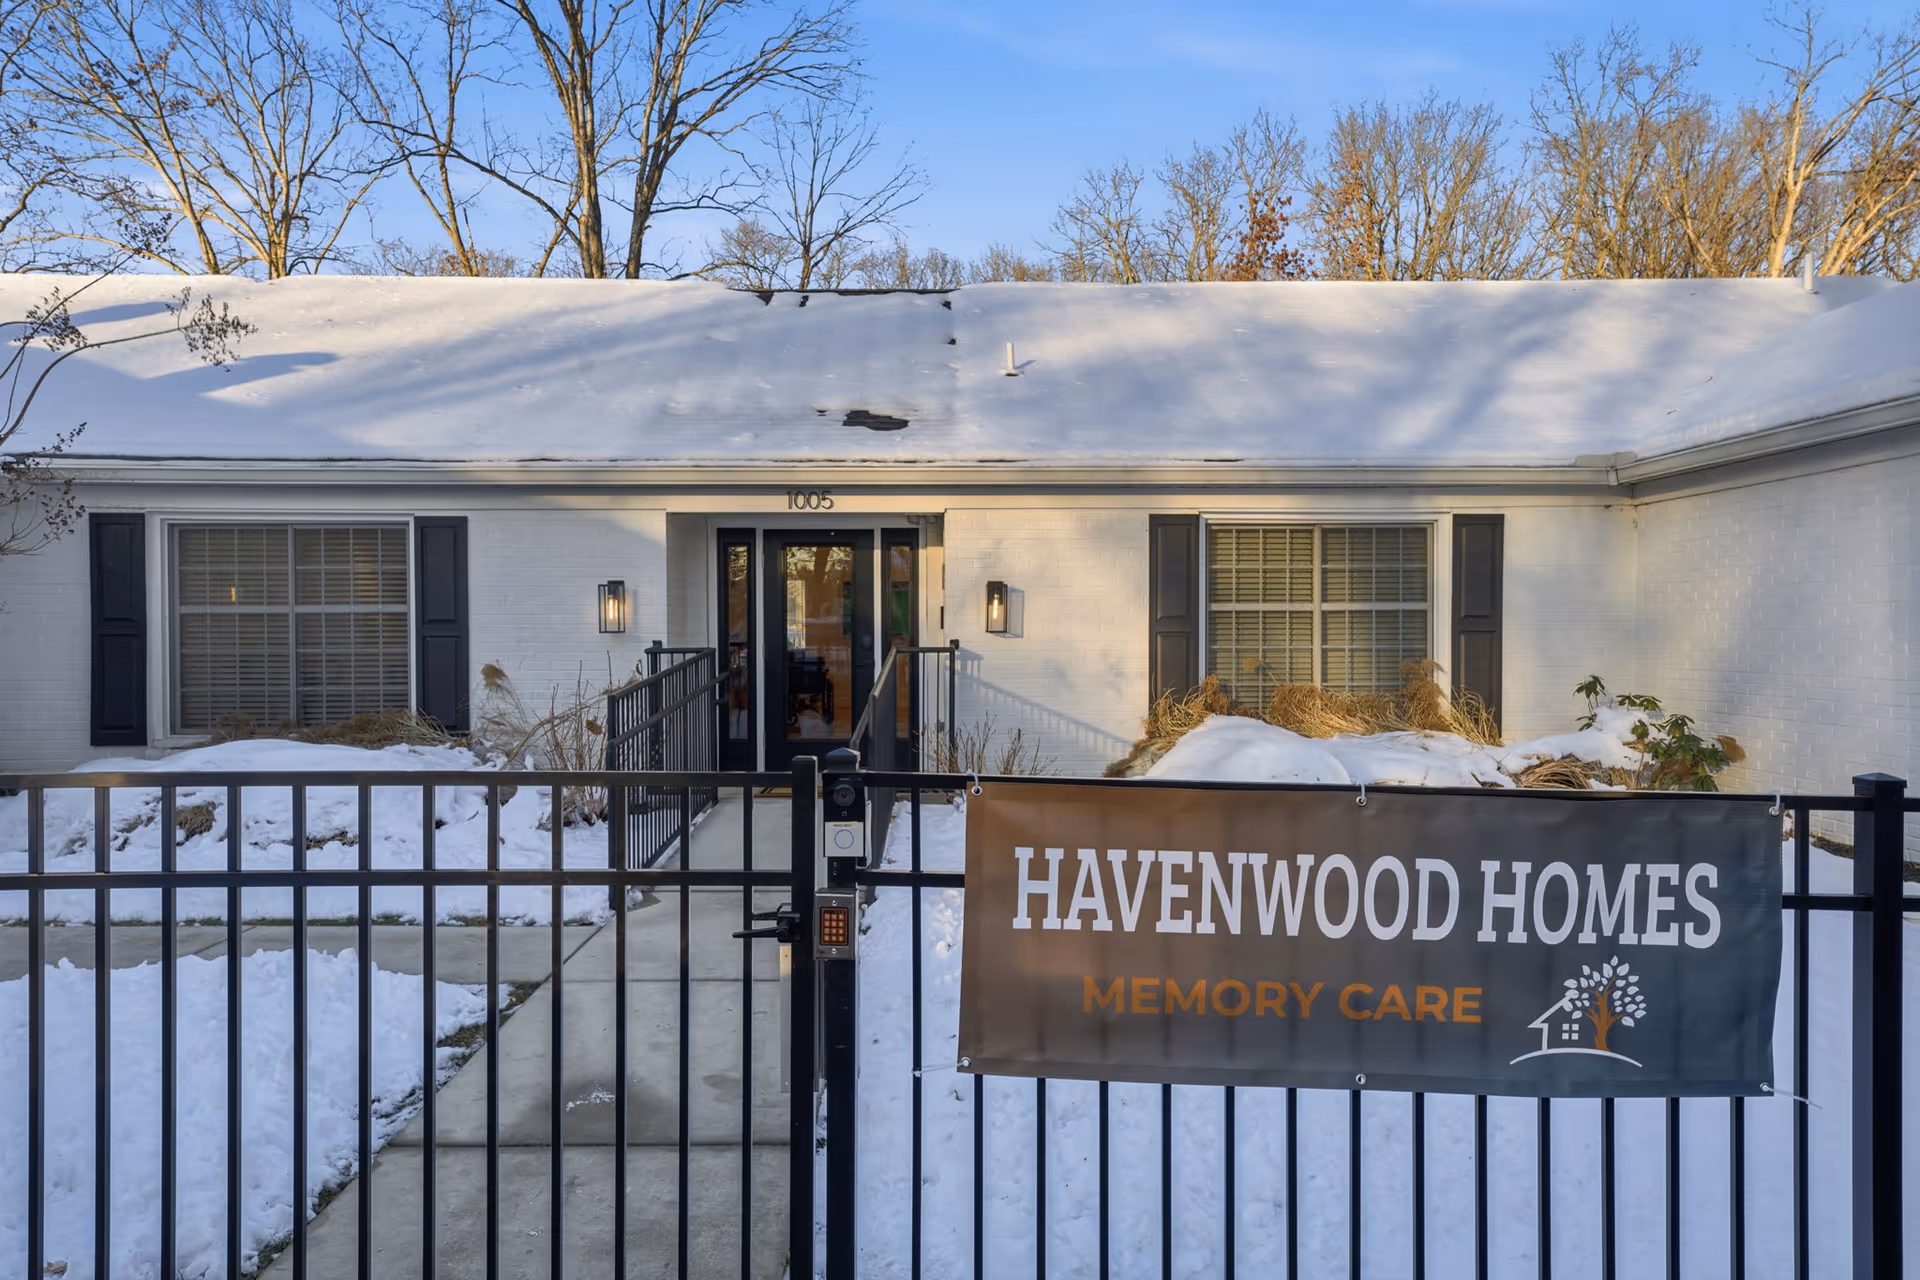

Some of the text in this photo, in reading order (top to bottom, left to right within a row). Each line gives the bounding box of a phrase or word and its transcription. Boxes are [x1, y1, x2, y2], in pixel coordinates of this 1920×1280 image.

[785, 490, 834, 510] 1005
[1012, 846, 1722, 949] HAVENWOOD HOMES
[1082, 975, 1483, 1024] MEMORY CARE
